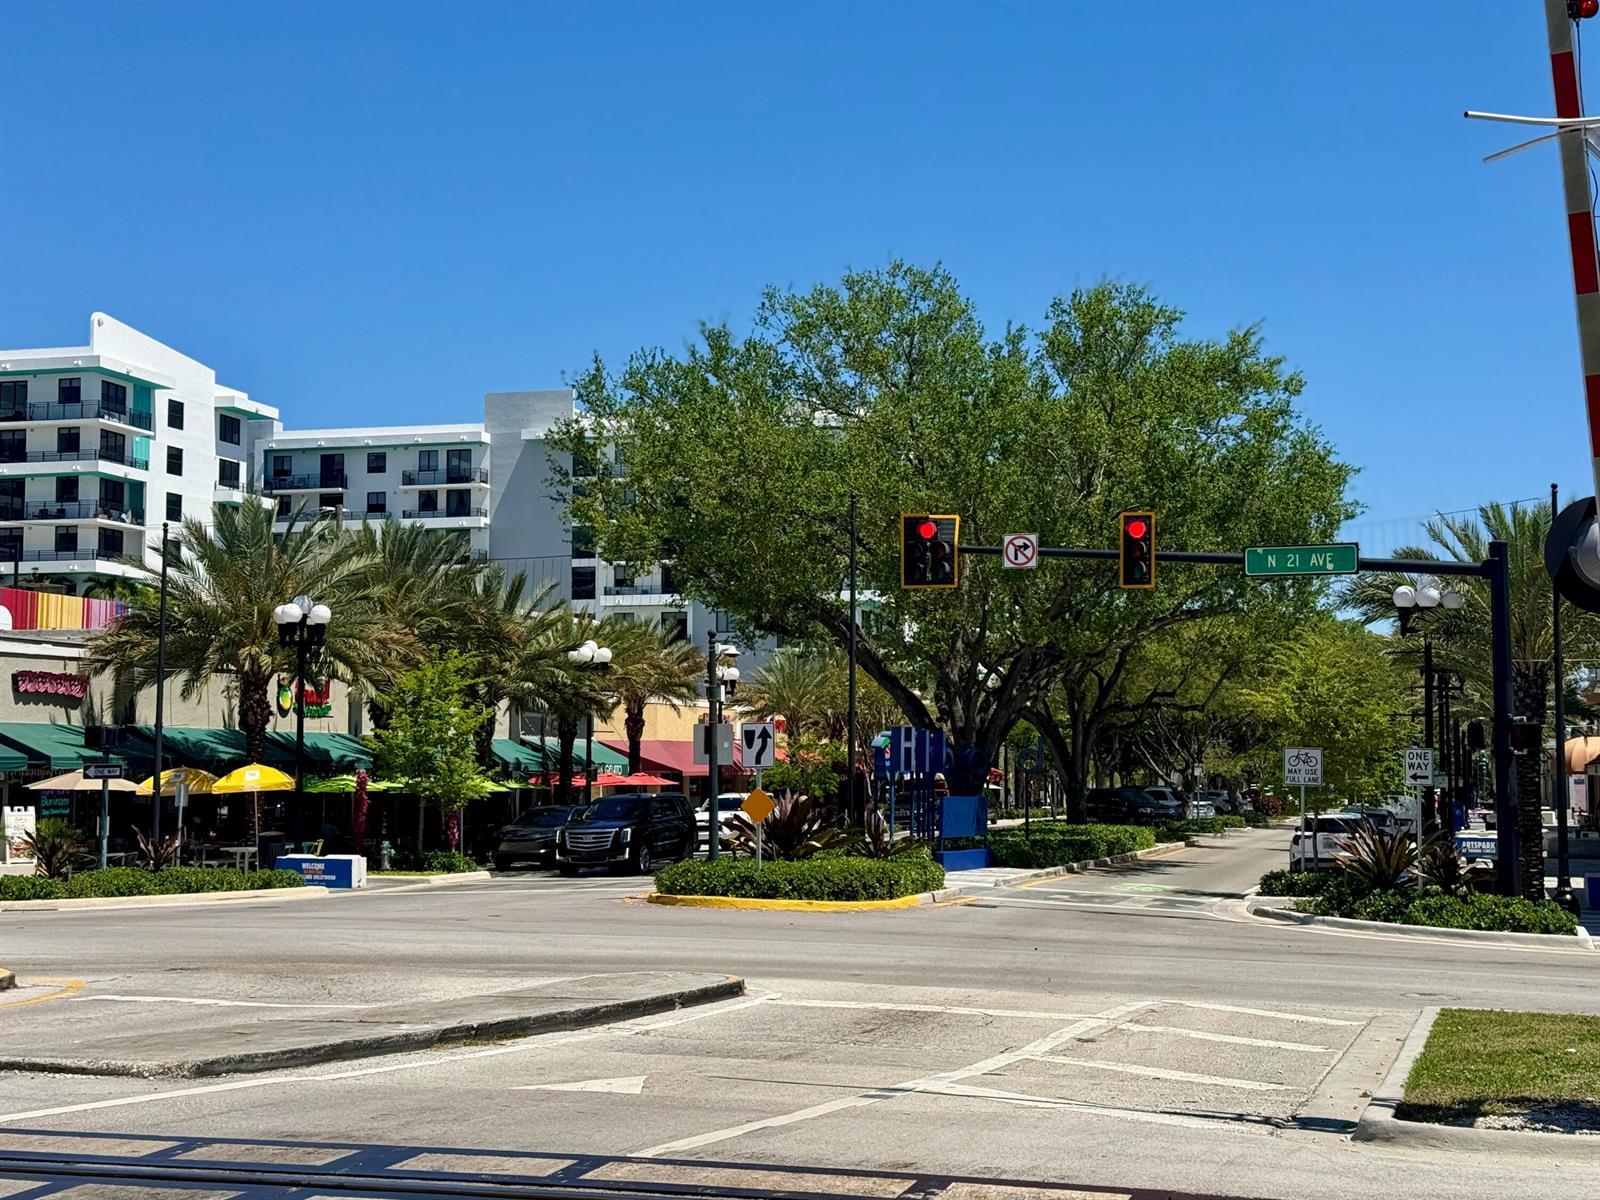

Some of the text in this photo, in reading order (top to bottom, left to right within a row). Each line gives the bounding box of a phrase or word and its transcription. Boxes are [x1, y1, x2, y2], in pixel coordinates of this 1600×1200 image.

[1268, 552, 1334, 568] N 21 AVE
[1408, 751, 1429, 761] ONE
[1408, 762, 1430, 771] WAY
[1305, 768, 1318, 776] USE
[1286, 775, 1320, 784] FULL LANE
[301, 862, 325, 870] WELCOME
